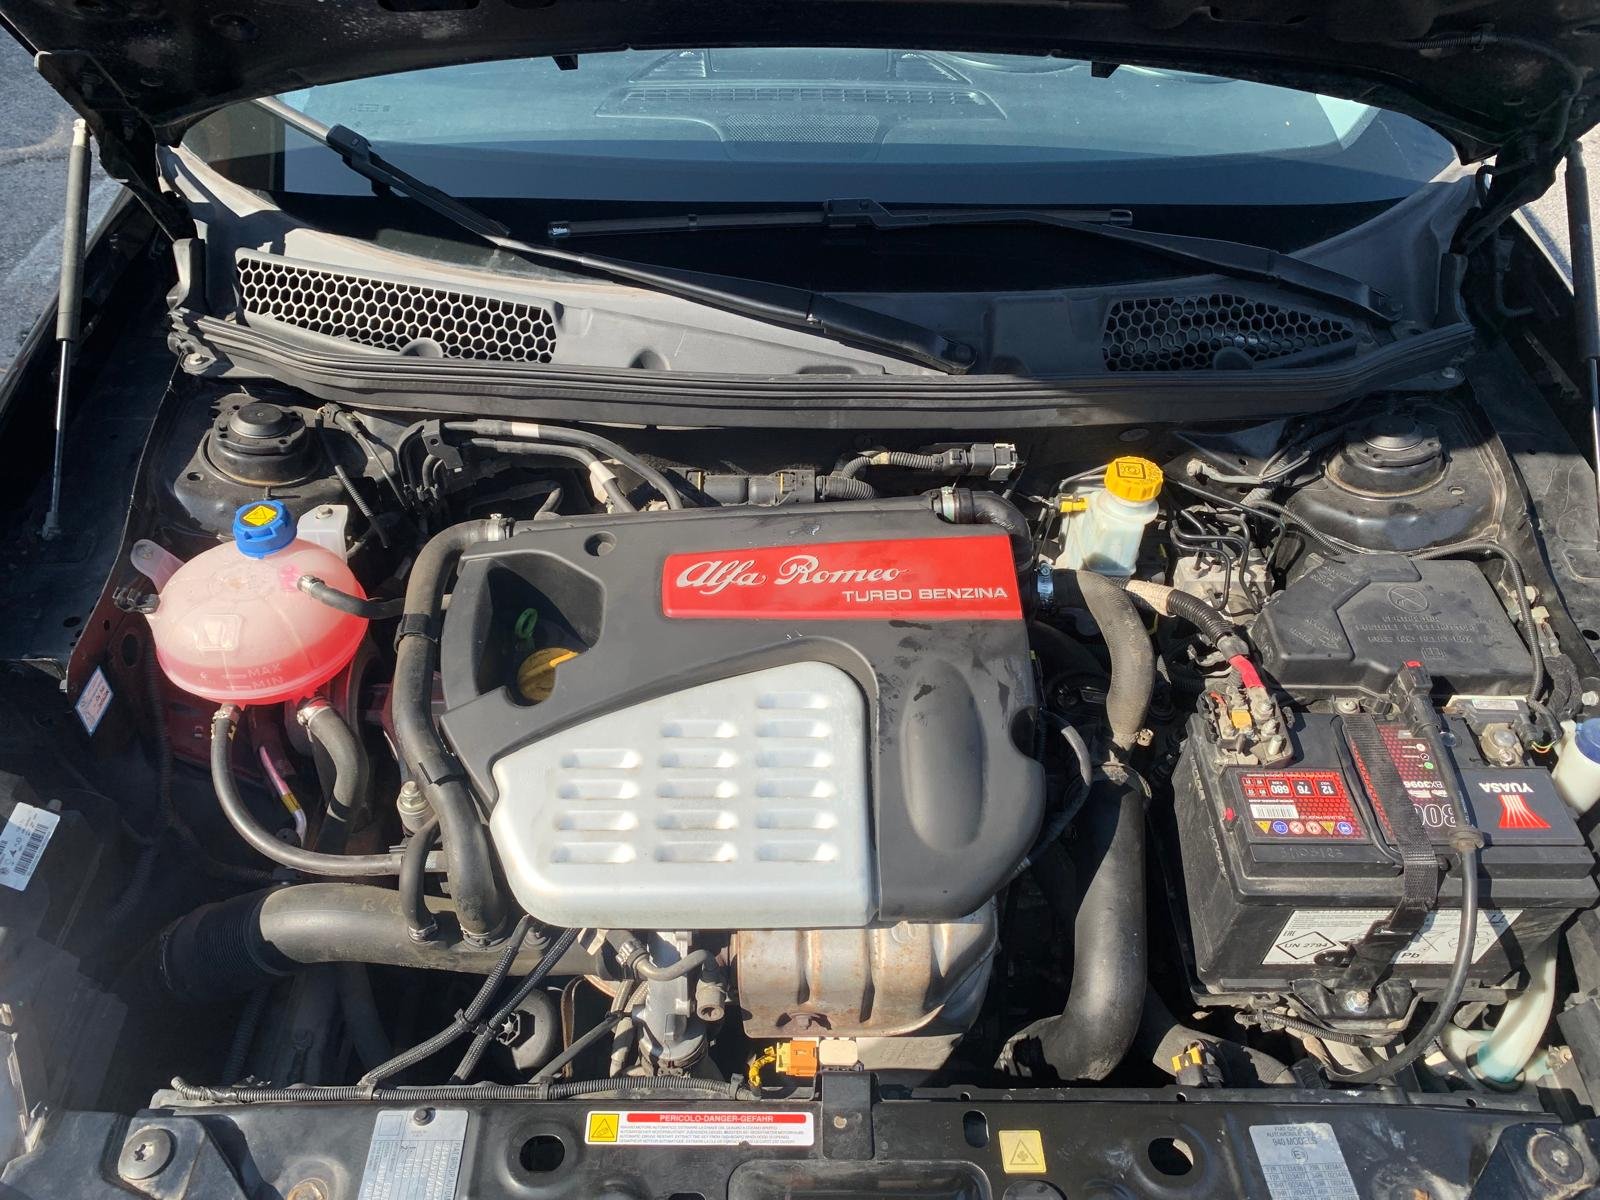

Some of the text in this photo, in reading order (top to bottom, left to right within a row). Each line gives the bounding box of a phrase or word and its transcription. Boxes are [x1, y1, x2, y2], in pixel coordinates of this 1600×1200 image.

[676, 555, 909, 595] Alfa Romeo
[842, 587, 1008, 602] TURBO BENZINA
[248, 663, 281, 677] MAX
[252, 676, 284, 688] MIN
[1270, 784, 1289, 794] 680
[1297, 785, 1311, 794] 76
[1321, 785, 1335, 794] 12
[1402, 780, 1443, 789] BX3096
[1478, 782, 1535, 793] YUASA
[659, 1114, 774, 1124] PERICOLO-DANGER-GEFAHR
